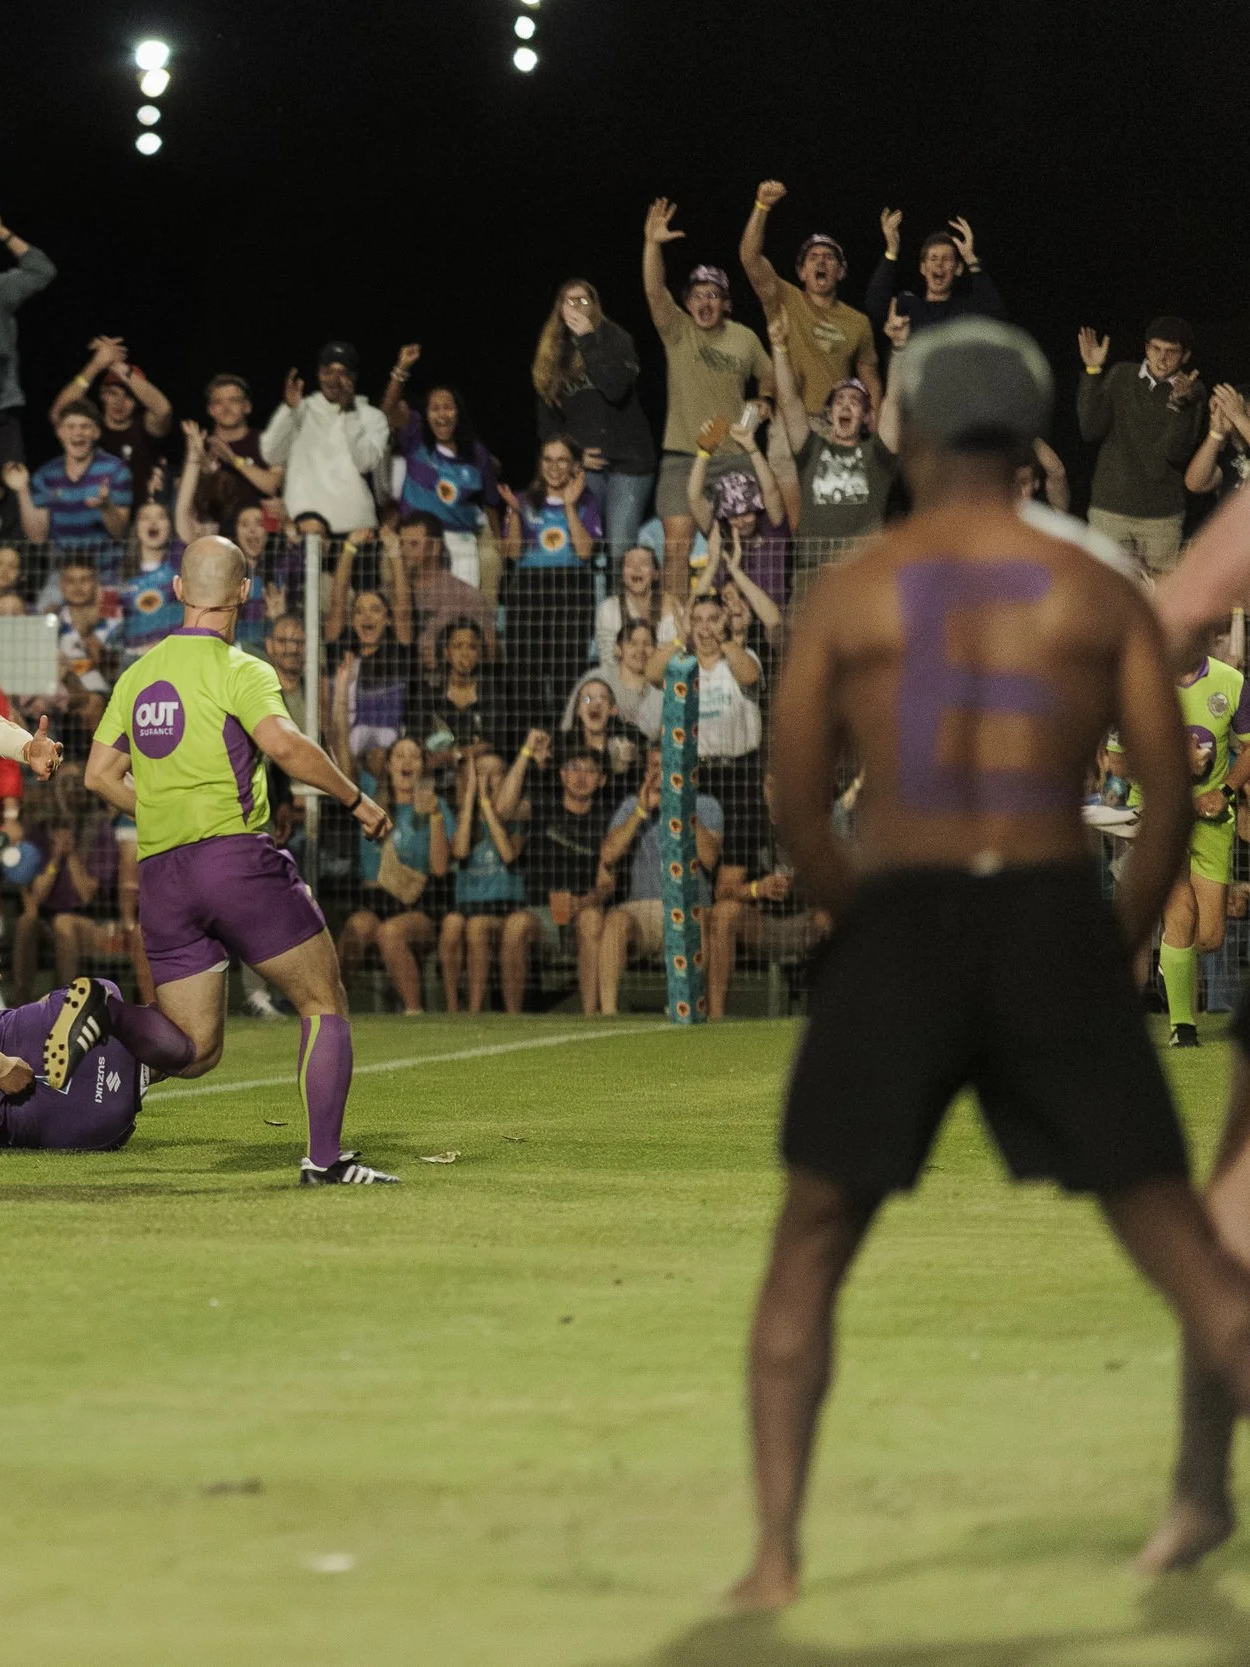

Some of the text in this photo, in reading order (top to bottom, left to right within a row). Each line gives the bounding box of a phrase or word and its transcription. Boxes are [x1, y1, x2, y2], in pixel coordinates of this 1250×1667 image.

[135, 702, 179, 727] OUT
[140, 728, 174, 737] SURANCE
[95, 1056, 105, 1103] SUZUKI
